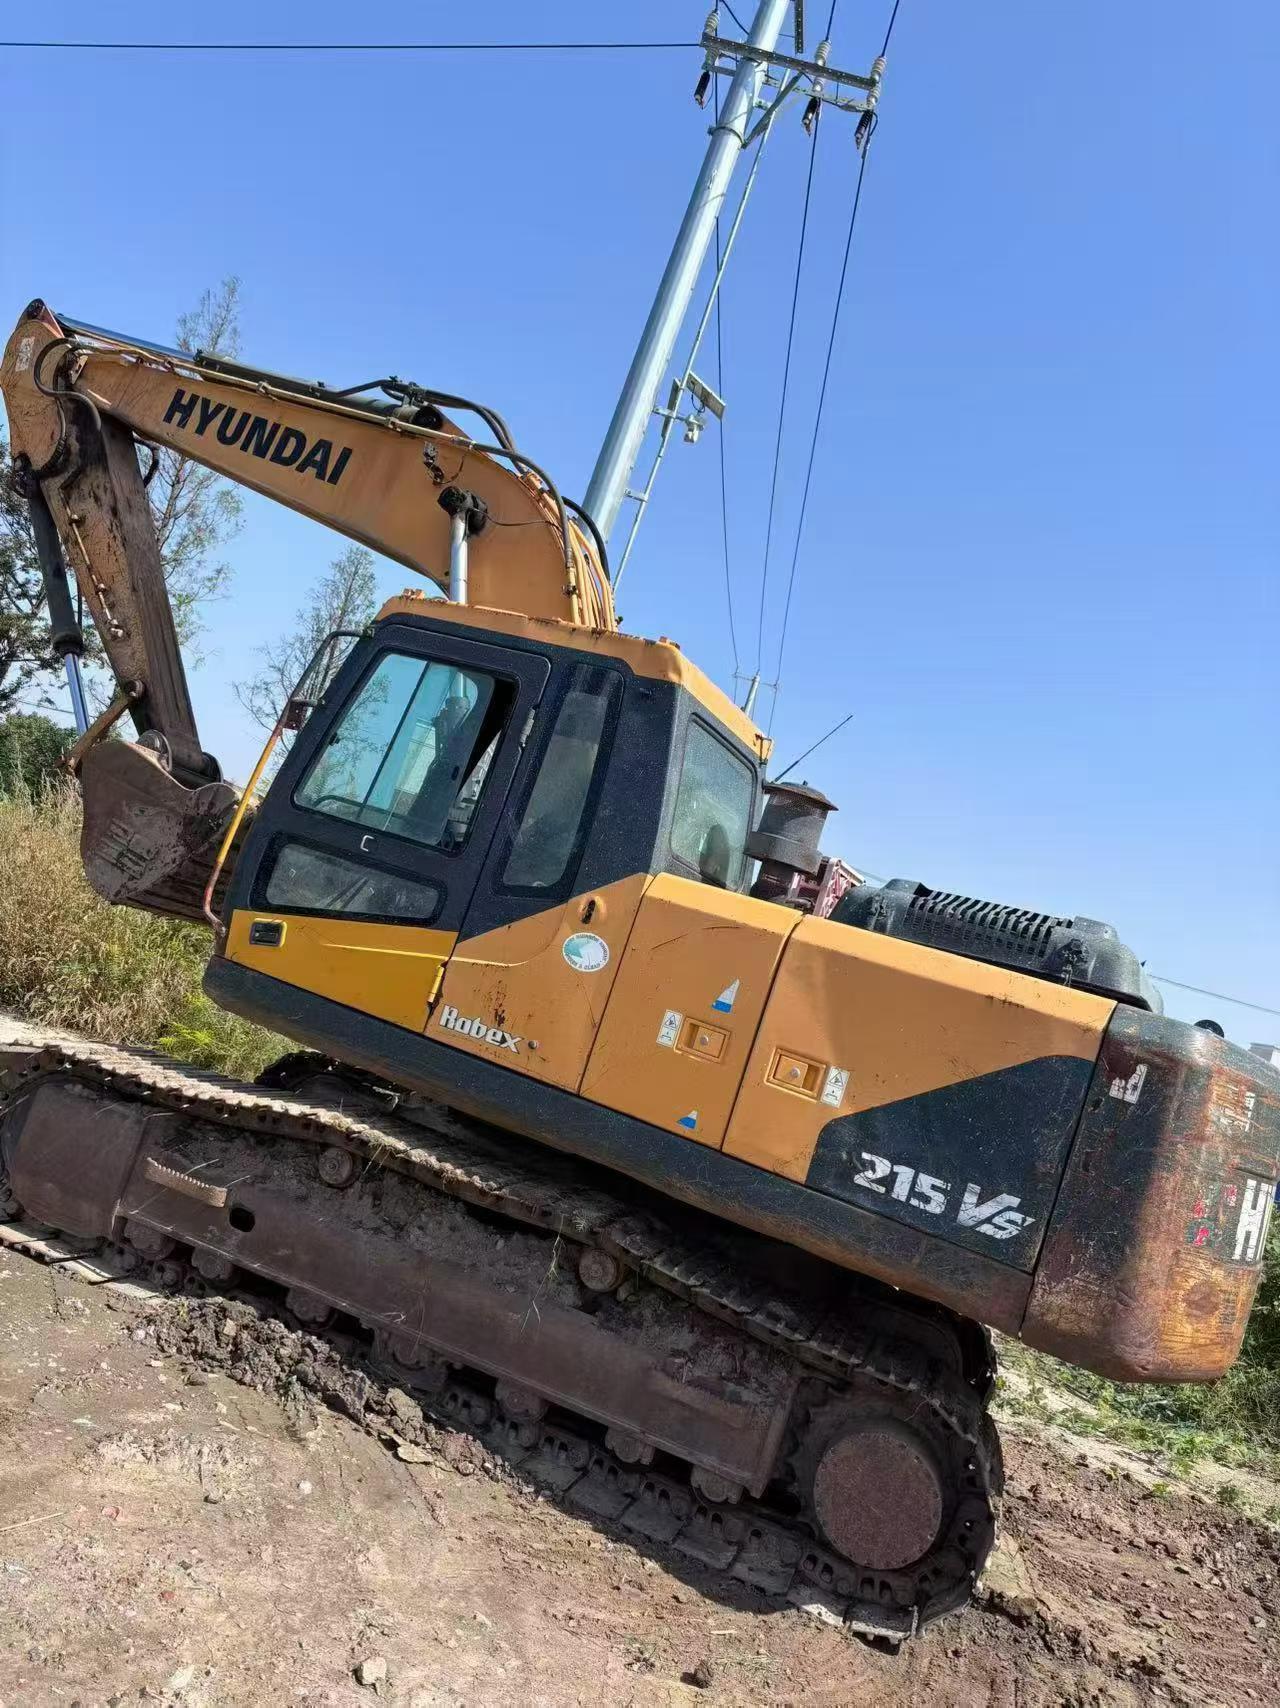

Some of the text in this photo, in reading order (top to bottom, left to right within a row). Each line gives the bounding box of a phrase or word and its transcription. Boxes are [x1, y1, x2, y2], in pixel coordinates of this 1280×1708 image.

[163, 388, 353, 485] HYUNDAI
[440, 1004, 523, 1053] Robex
[853, 1152, 951, 1214] 215
